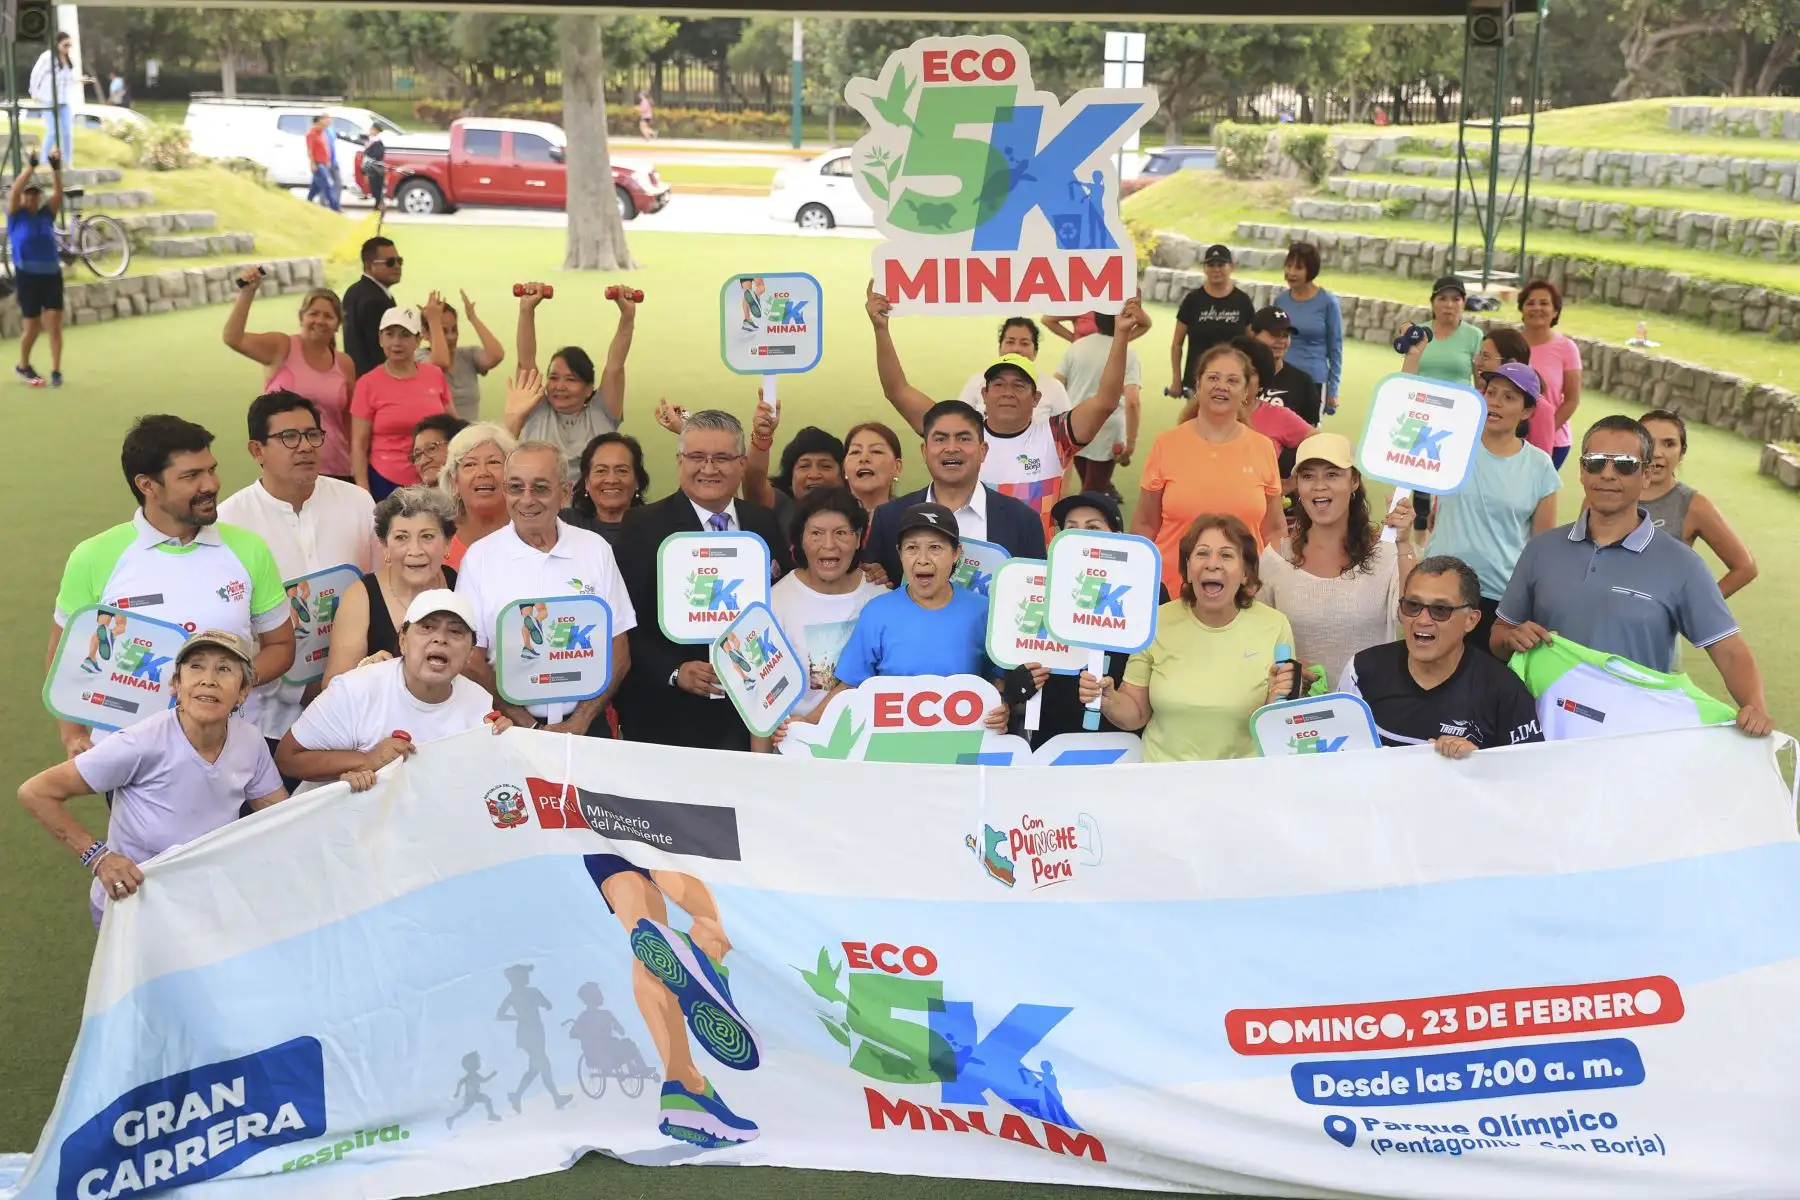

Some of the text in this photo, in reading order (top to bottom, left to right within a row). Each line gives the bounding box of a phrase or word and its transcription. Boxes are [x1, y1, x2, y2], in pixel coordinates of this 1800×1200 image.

[923, 48, 1016, 82] ECO
[886, 85, 1145, 251] 5K
[884, 256, 1123, 304] MINAM
[767, 298, 809, 324] 5K
[766, 324, 807, 334] MINAM
[1408, 410, 1430, 421] ECO
[1391, 417, 1453, 461] 5K
[1386, 451, 1441, 472] MINAM
[697, 567, 718, 575] ECO
[964, 558, 980, 567] ECO
[1086, 568, 1107, 577] ECO
[319, 588, 335, 597] ECO
[688, 575, 745, 610] 5K
[1030, 595, 1045, 603] EC
[1075, 576, 1132, 618] 5K
[1072, 612, 1126, 630] MINAM
[133, 637, 153, 648] ECO
[549, 622, 597, 650] 5K
[745, 630, 756, 643] ECO
[1015, 638, 1069, 653] MINAM
[115, 643, 174, 683] 5K
[549, 649, 594, 660] MINAM
[759, 650, 784, 680] MINAM
[110, 671, 161, 693] MINAM
[874, 690, 984, 727] ECO
[1296, 730, 1319, 739] ECO
[1510, 719, 1543, 745] LIM
[586, 804, 650, 829] Ministerio
[1022, 814, 1044, 831] Con
[590, 817, 673, 845] del Ambiente
[1031, 857, 1073, 884] Perú
[841, 941, 938, 976] ECO
[1245, 988, 1661, 1045] DOMINGO, 23 DE FEBRERO
[846, 973, 1087, 1132] 5K
[1312, 1057, 1624, 1098] Desde las 7:00 a. m.
[112, 1076, 246, 1147] GRAN
[863, 1086, 1107, 1163] MINAM
[1360, 1109, 1618, 1139] Parque Olímpico
[76, 1101, 306, 1200] CARRERA
[282, 1124, 410, 1173] respira.
[1590, 1133, 1666, 1156] Borja)
